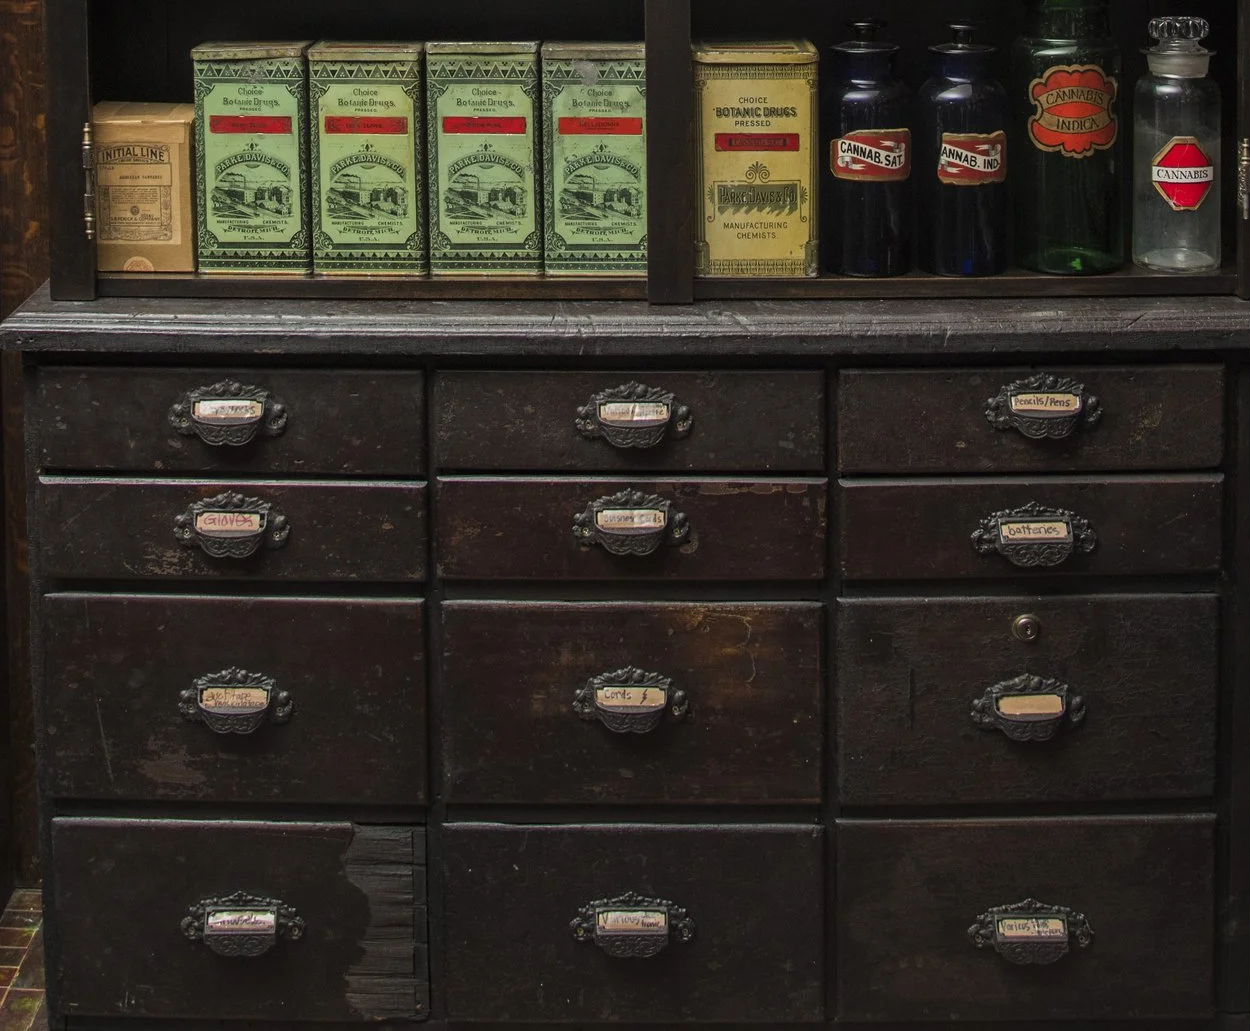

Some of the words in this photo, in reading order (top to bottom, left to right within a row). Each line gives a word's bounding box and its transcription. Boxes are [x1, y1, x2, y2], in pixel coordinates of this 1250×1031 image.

[238, 87, 263, 97] Choice
[353, 88, 378, 97] Choice
[471, 87, 497, 97] Choice
[587, 88, 613, 97] Choice
[1046, 88, 1105, 107] CANNABIS
[715, 106, 761, 118] BOTANIC
[763, 106, 797, 118] DRUGS
[1056, 117, 1100, 131] INDICA
[102, 147, 138, 162] INITIAL
[141, 147, 165, 162] LINE
[245, 153, 272, 165] DAVIS
[361, 154, 386, 165] DAVIS
[479, 154, 506, 165] DAVIS
[595, 154, 621, 165] DAVIS
[840, 141, 883, 164] CANNAB.
[885, 154, 904, 168] SAT.
[1156, 168, 1209, 180] CANNABIS
[748, 186, 775, 204] DAVIS
[775, 193, 783, 204] &
[723, 222, 788, 230] MANUFACTURING
[1014, 395, 1070, 407] Pencils/Pens
[1008, 525, 1060, 536] batteries
[604, 690, 632, 700] Cords
